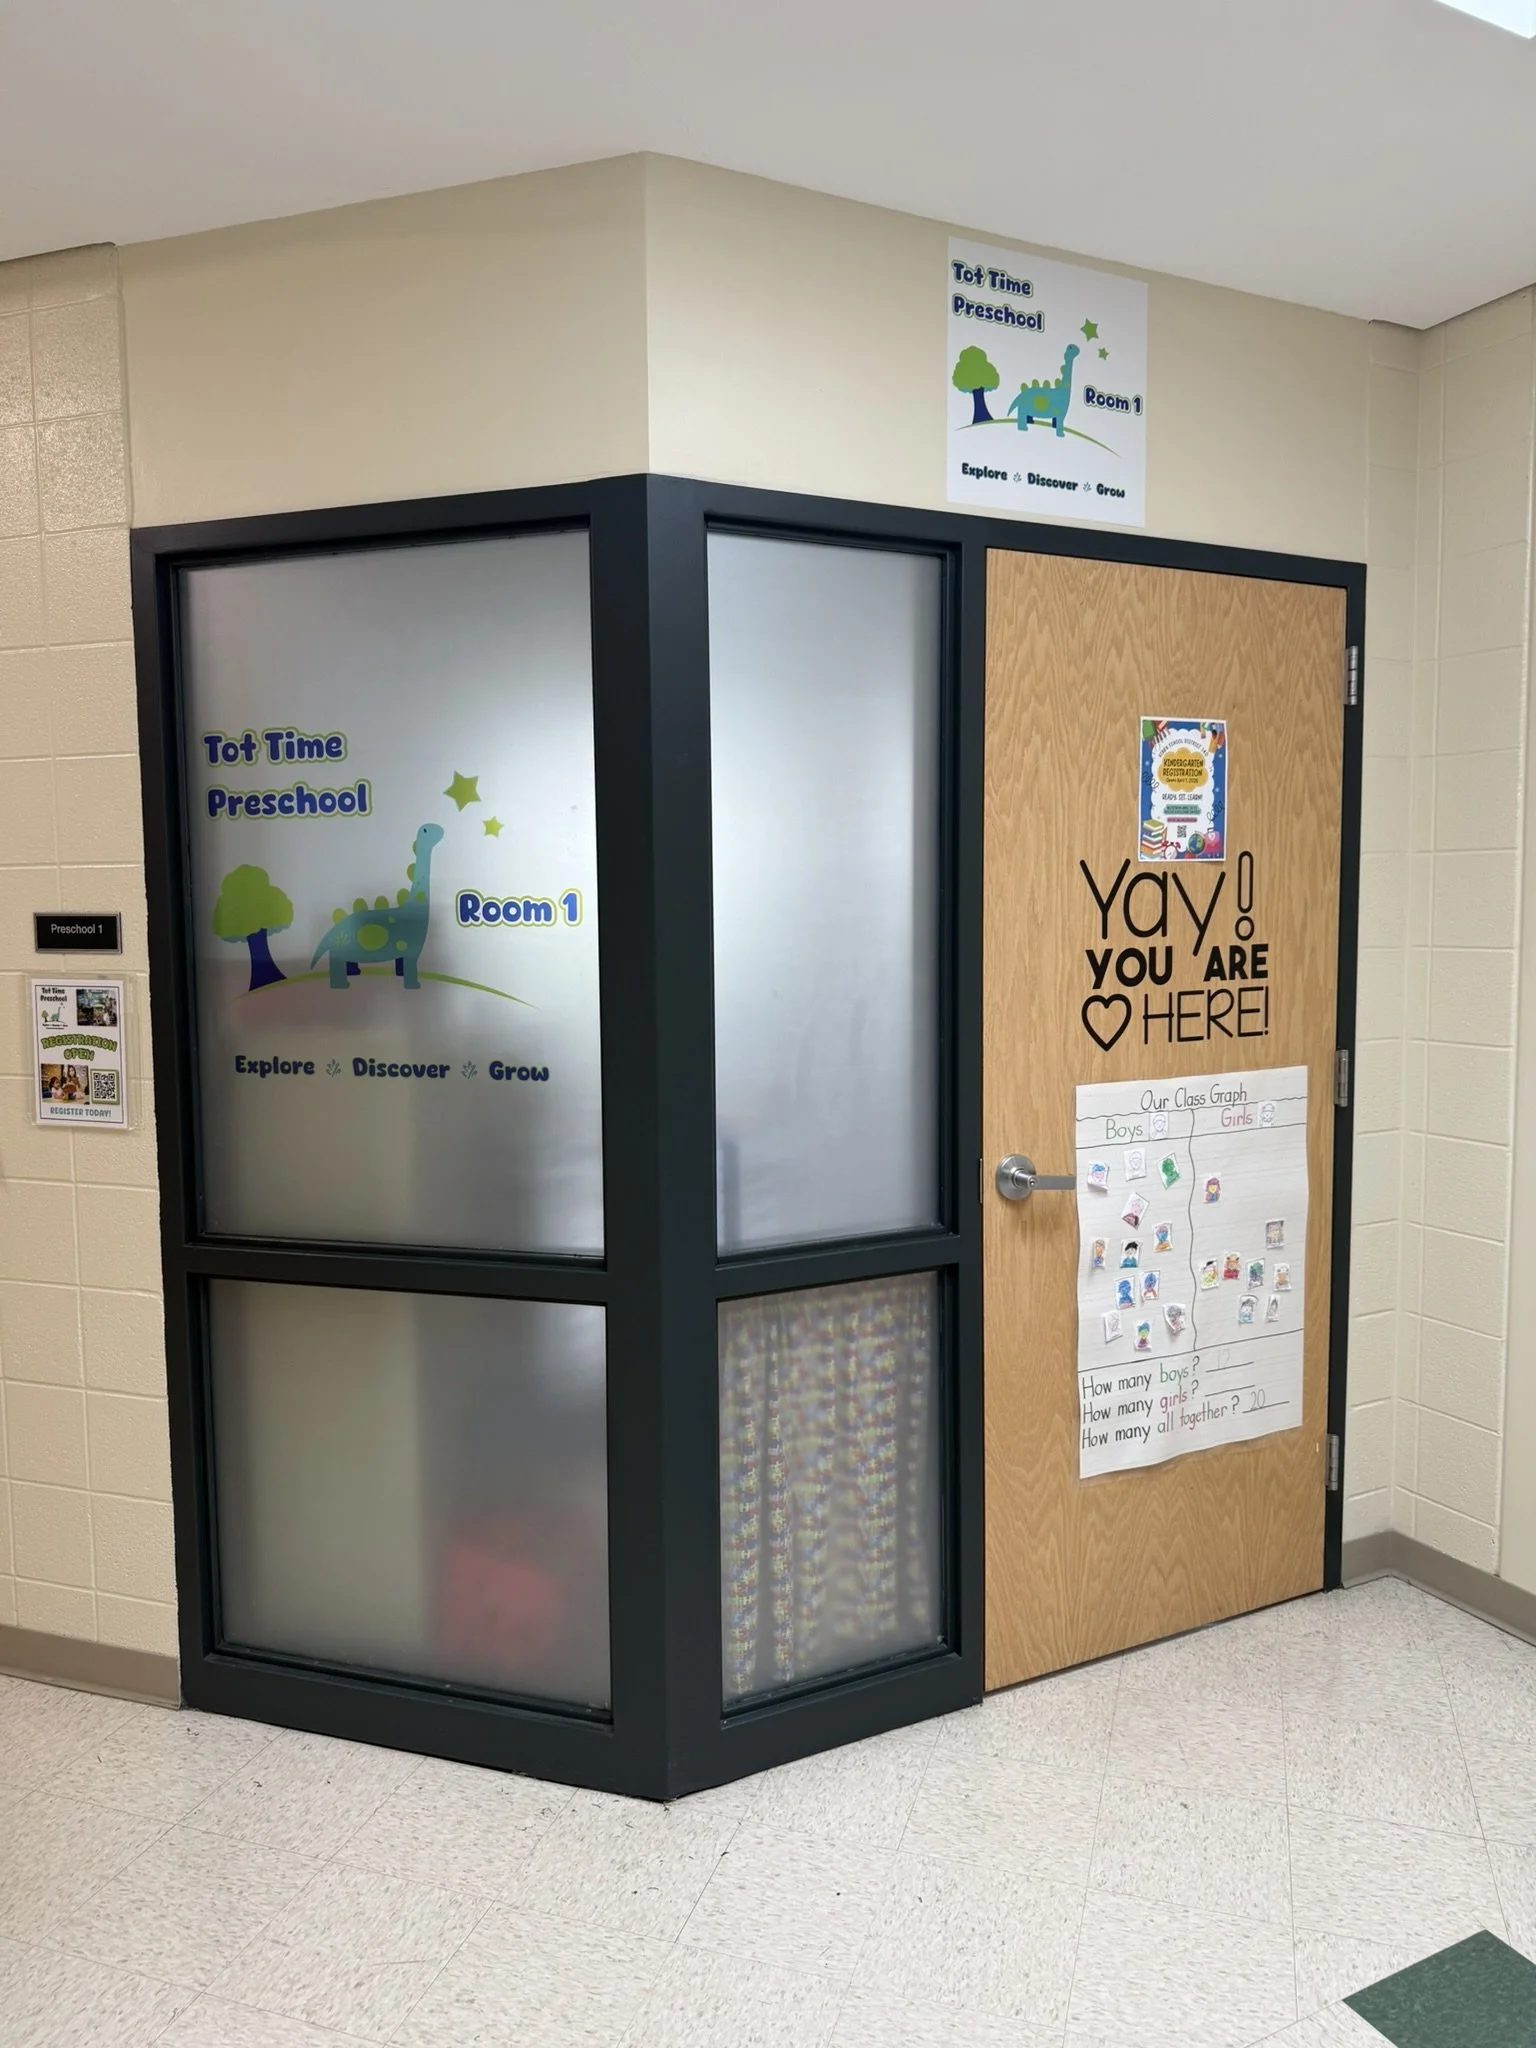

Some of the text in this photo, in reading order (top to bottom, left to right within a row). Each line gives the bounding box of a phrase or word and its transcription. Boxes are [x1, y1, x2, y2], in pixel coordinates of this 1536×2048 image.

[953, 262, 1033, 297] Tot Time
[952, 293, 1045, 333] Preschool
[1085, 386, 1142, 415] Room 1
[961, 462, 1126, 499] Explore Discover Grow
[202, 728, 346, 767] Tot Time
[1163, 758, 1204, 768] KINDERGARTEN
[1162, 767, 1203, 777] REGISTRATION
[206, 778, 371, 820] Preschool
[455, 888, 581, 927] Room 1
[1079, 850, 1256, 957] Yay!
[50, 923, 103, 934] Preschool 1
[1085, 943, 1269, 990] YOU ARE
[1142, 985, 1269, 1045] HERE!
[41, 1034, 118, 1052] REGISTRATION
[63, 1048, 95, 1061] OPEN
[234, 1055, 550, 1082] Explore Discover Grow
[50, 1106, 112, 1117] REGISTER TODAY!
[1140, 1082, 1247, 1111] Our Class Graph
[1105, 1108, 1253, 1143] Boys Girls
[1081, 1376, 1113, 1399] How
[1118, 1374, 1152, 1391] many
[1082, 1428, 1109, 1449] How
[1115, 1425, 1151, 1444] many
[1157, 1412, 1174, 1434] all
[1250, 1389, 1266, 1410] 20
[1083, 1403, 1113, 1424] How
[1117, 1398, 1153, 1418] many
